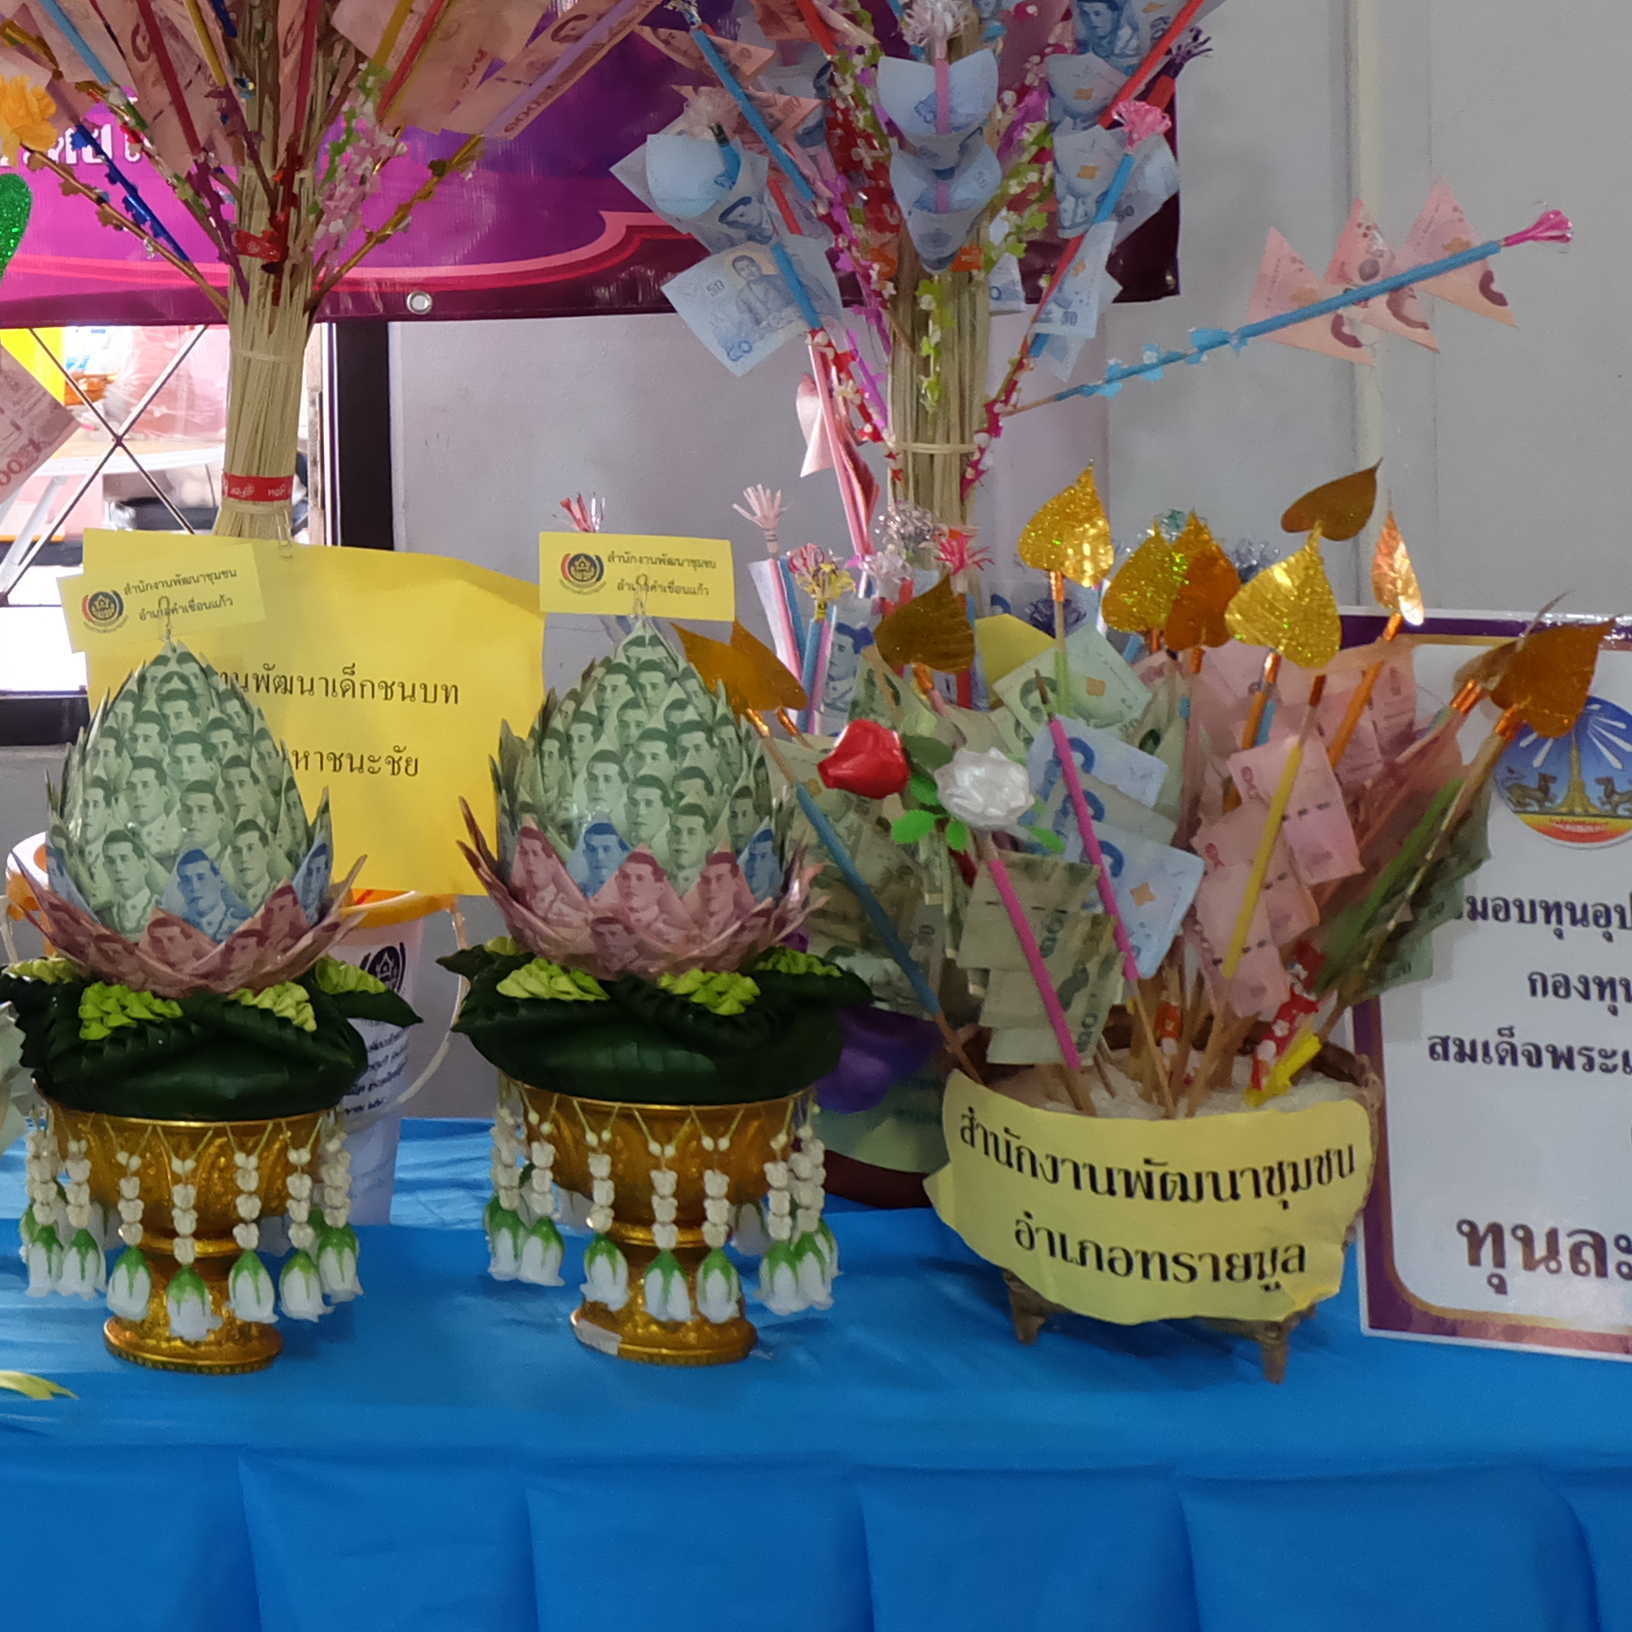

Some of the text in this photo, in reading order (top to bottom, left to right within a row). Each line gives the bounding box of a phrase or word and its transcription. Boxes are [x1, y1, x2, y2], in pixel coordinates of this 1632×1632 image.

[286, 744, 420, 779] หาชนะชัย
[959, 1106, 1356, 1211] สำนักงานพัฒนาชุมชน
[1014, 1211, 1307, 1293] อำเภอทรายมูล
